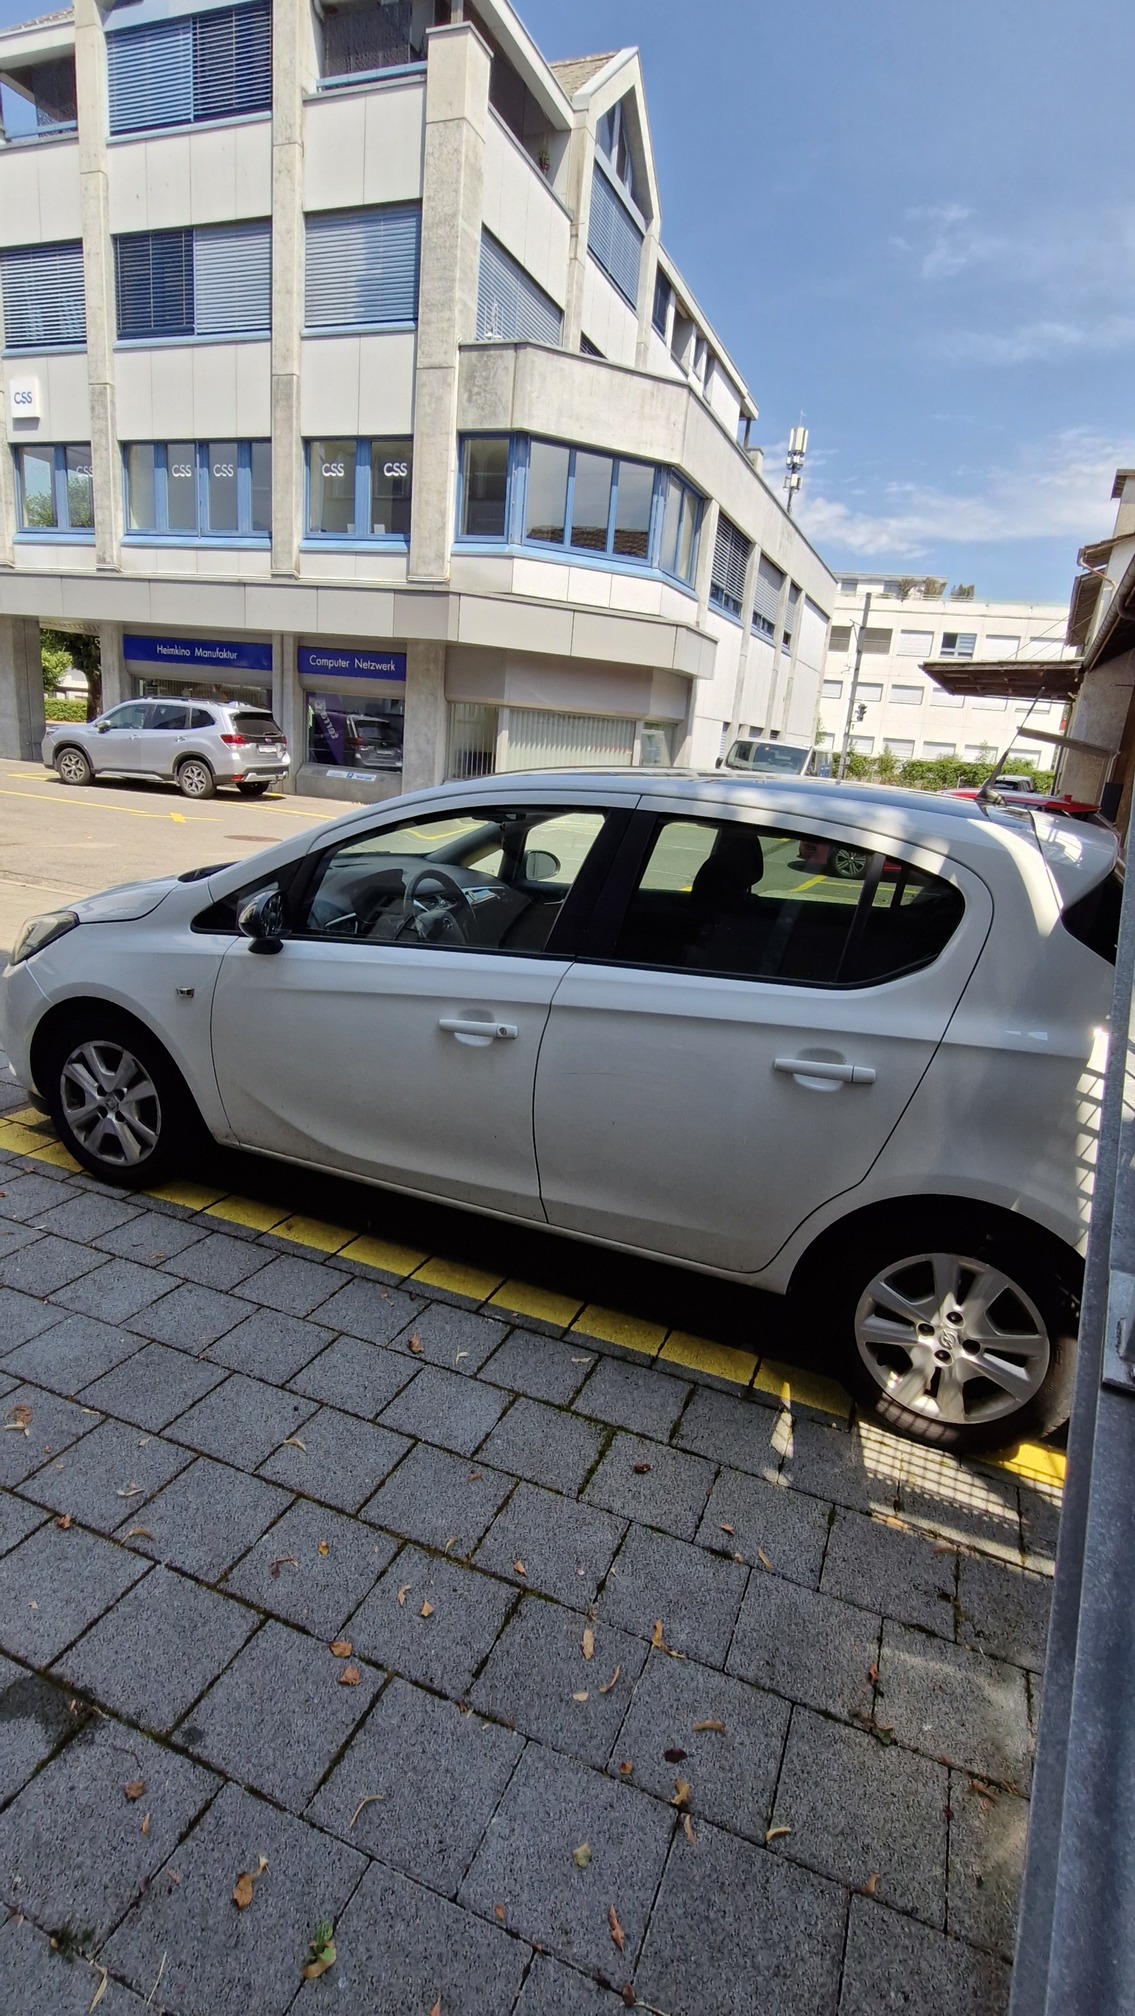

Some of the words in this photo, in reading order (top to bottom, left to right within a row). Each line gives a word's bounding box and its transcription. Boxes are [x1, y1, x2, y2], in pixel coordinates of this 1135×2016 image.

[14, 391, 32, 404] CSS
[172, 464, 192, 477] CSS
[213, 464, 234, 477] CSS
[322, 463, 345, 476] CSS
[383, 463, 407, 476] CSS
[156, 644, 191, 656] Heimkino
[194, 647, 238, 659] Manufaktur
[309, 654, 350, 669] Computer
[354, 657, 396, 672] Netzwerk
